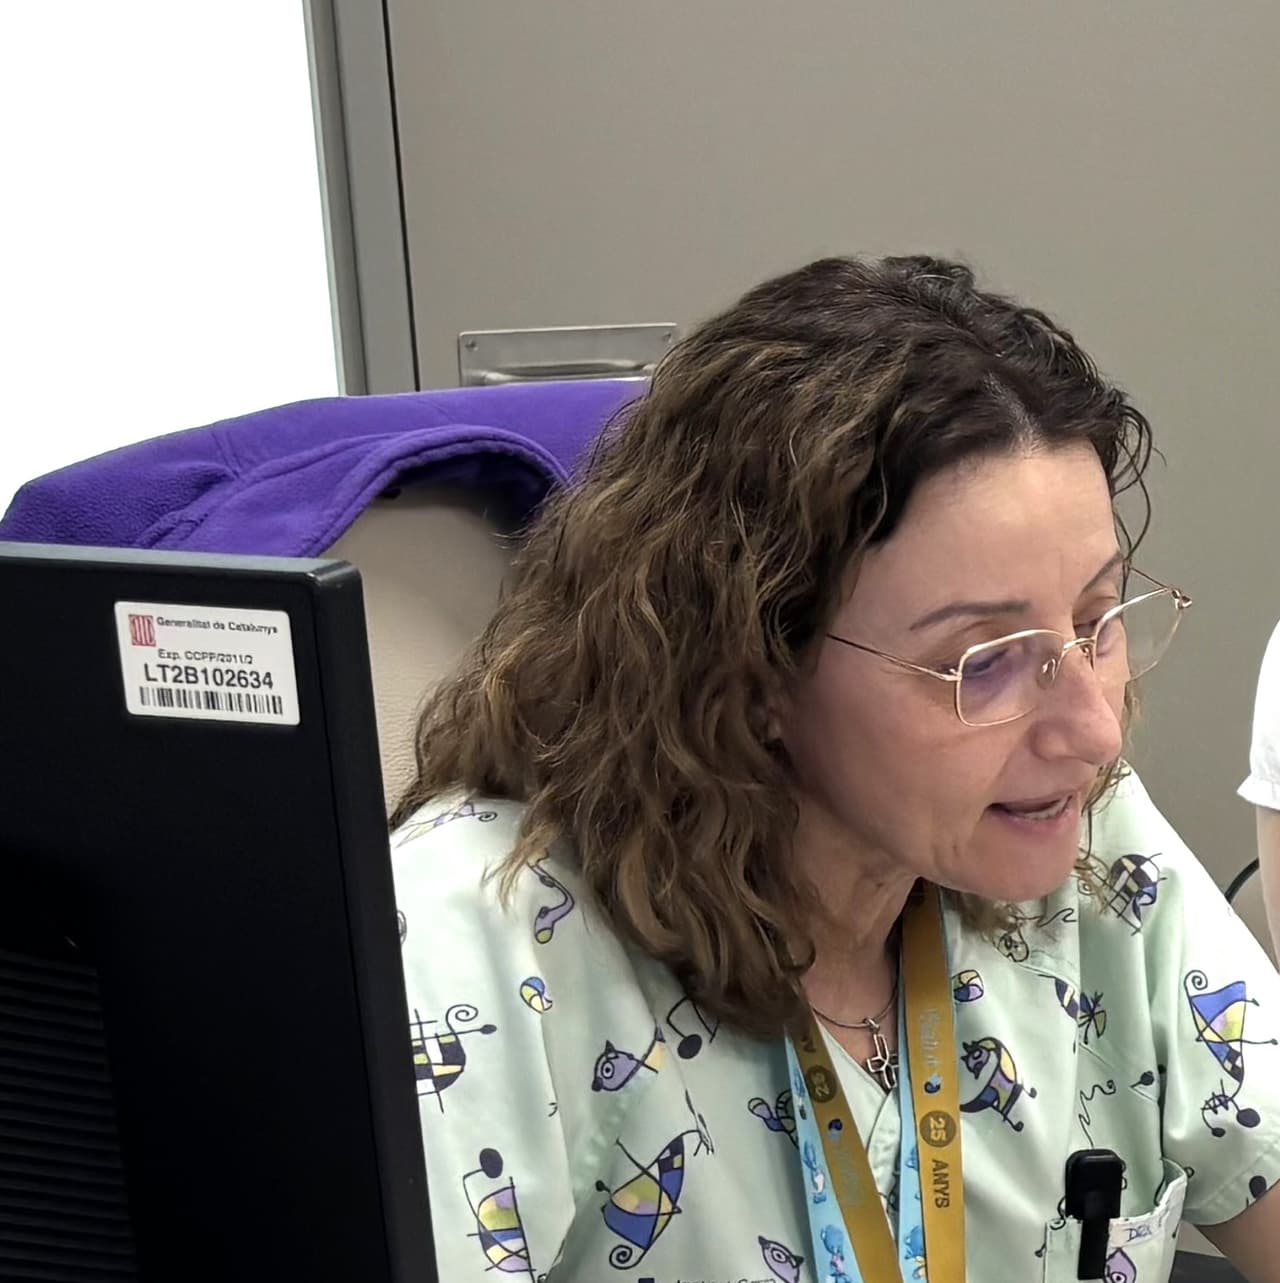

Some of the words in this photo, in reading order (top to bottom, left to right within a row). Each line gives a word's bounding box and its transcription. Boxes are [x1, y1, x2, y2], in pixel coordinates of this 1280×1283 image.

[156, 616, 212, 630] Generalitat
[213, 621, 226, 631] de
[228, 621, 279, 635] Catalunya
[158, 648, 182, 661] Exp.
[143, 663, 275, 690] LT2B102634
[927, 1117, 947, 1141] 25
[931, 1158, 952, 1210] ANYS
